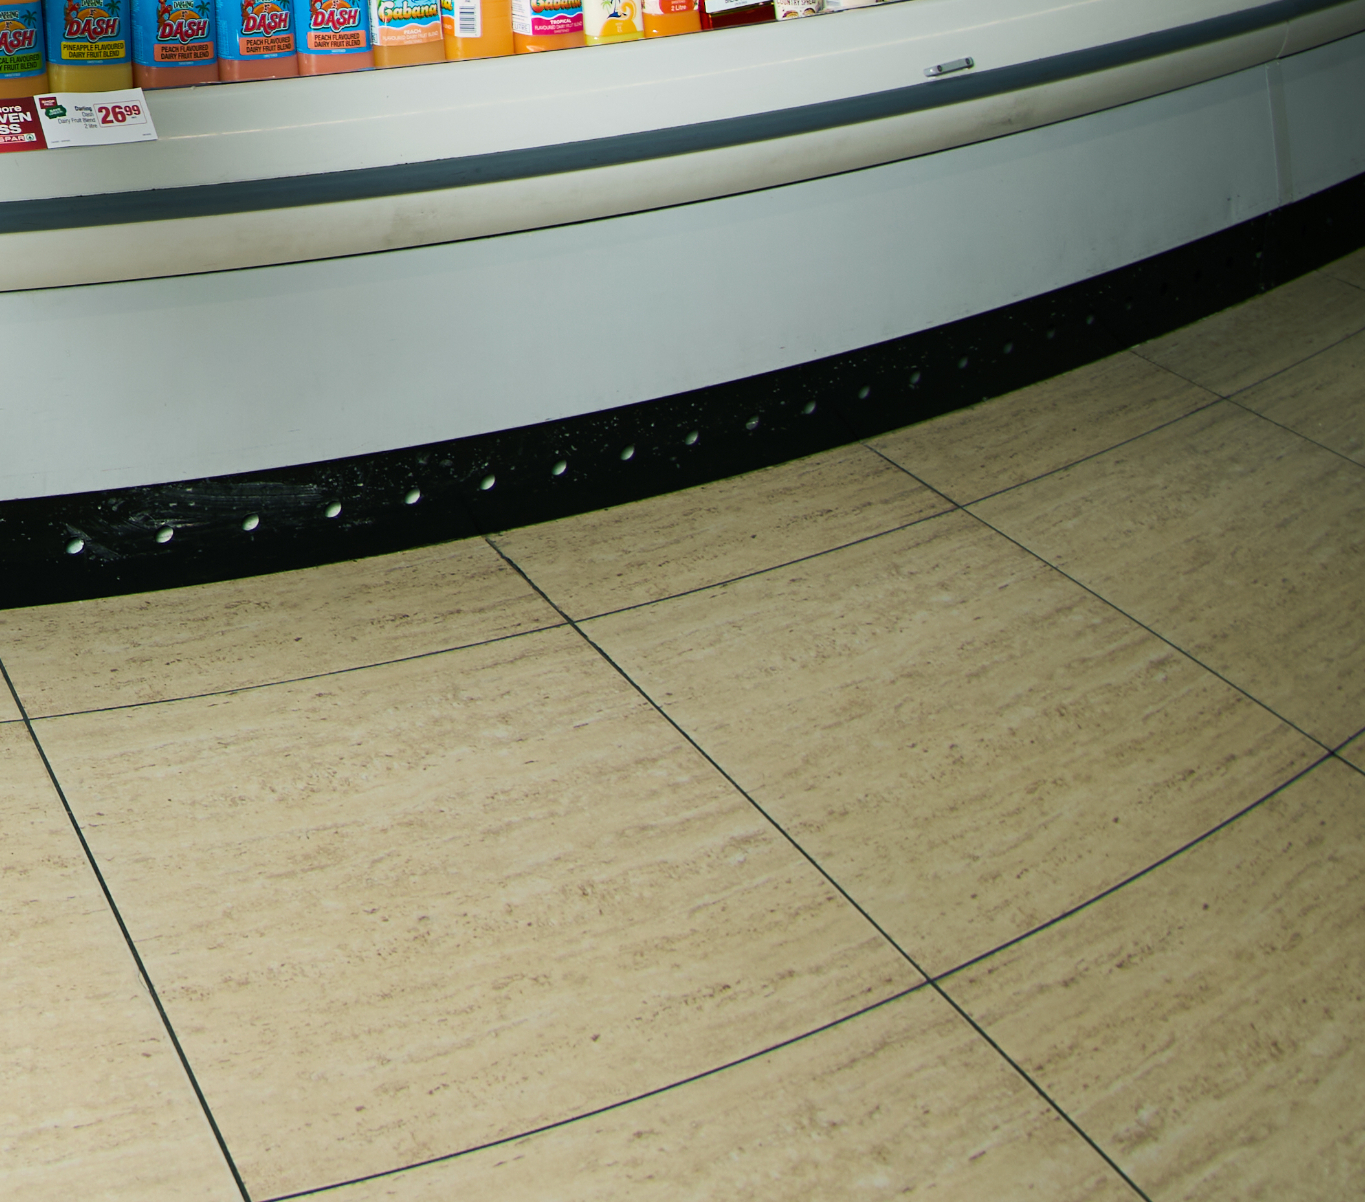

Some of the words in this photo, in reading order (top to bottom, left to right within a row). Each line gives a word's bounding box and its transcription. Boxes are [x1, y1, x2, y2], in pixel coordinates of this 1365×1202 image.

[379, 1, 438, 22] Gabana
[676, 4, 686, 12] Litre
[312, 8, 359, 32] DASH
[66, 18, 119, 42] DASH
[159, 19, 208, 42] DASH
[63, 43, 92, 51] PINEAPPLE
[94, 42, 124, 50] FLAVOURED
[161, 45, 177, 53] PEACH
[178, 44, 208, 52] FLAVOURED
[8, 55, 40, 63] FLAVOURED
[3, 63, 19, 71] FRUIT
